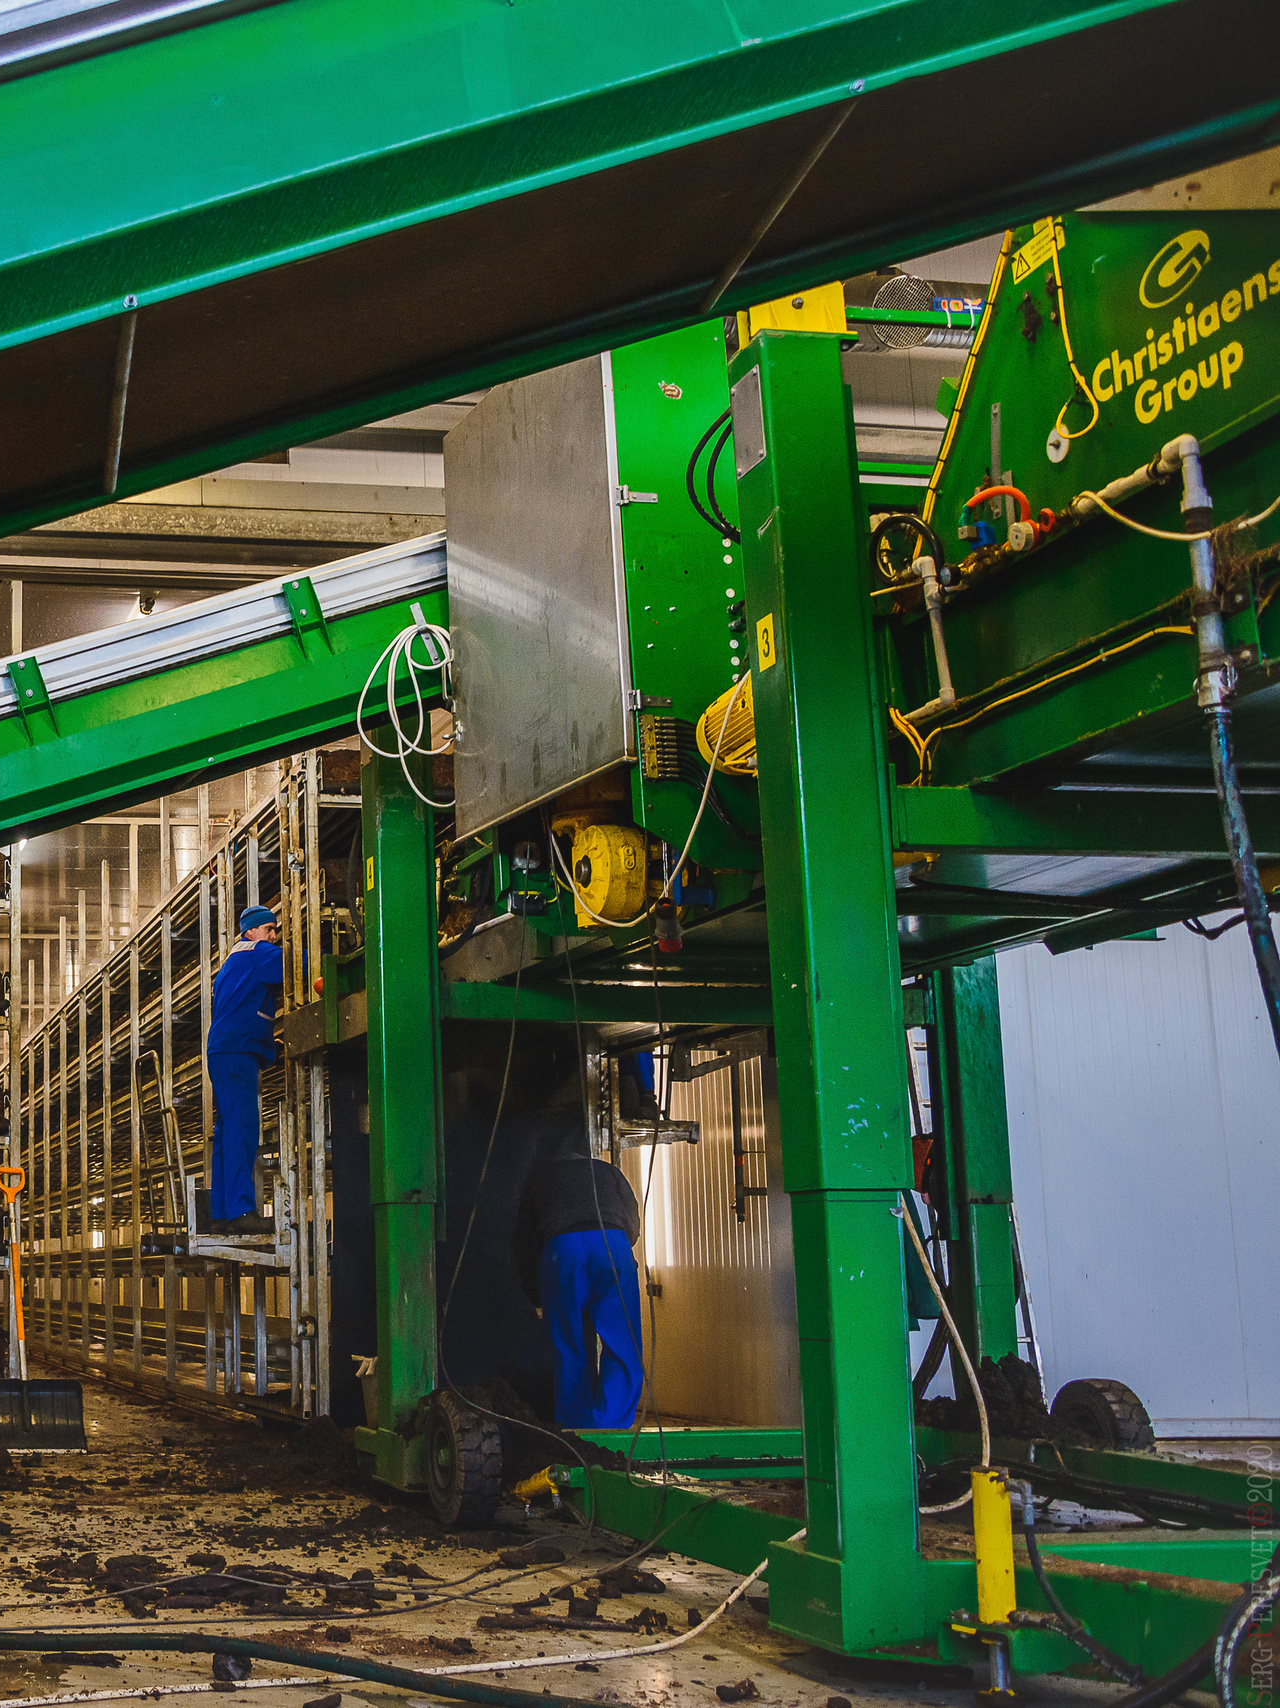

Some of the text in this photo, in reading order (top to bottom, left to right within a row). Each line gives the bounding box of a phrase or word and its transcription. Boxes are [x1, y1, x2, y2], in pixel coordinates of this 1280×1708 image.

[1092, 260, 1280, 402] Christiaens
[1134, 341, 1244, 424] Group
[762, 628, 770, 657] 3
